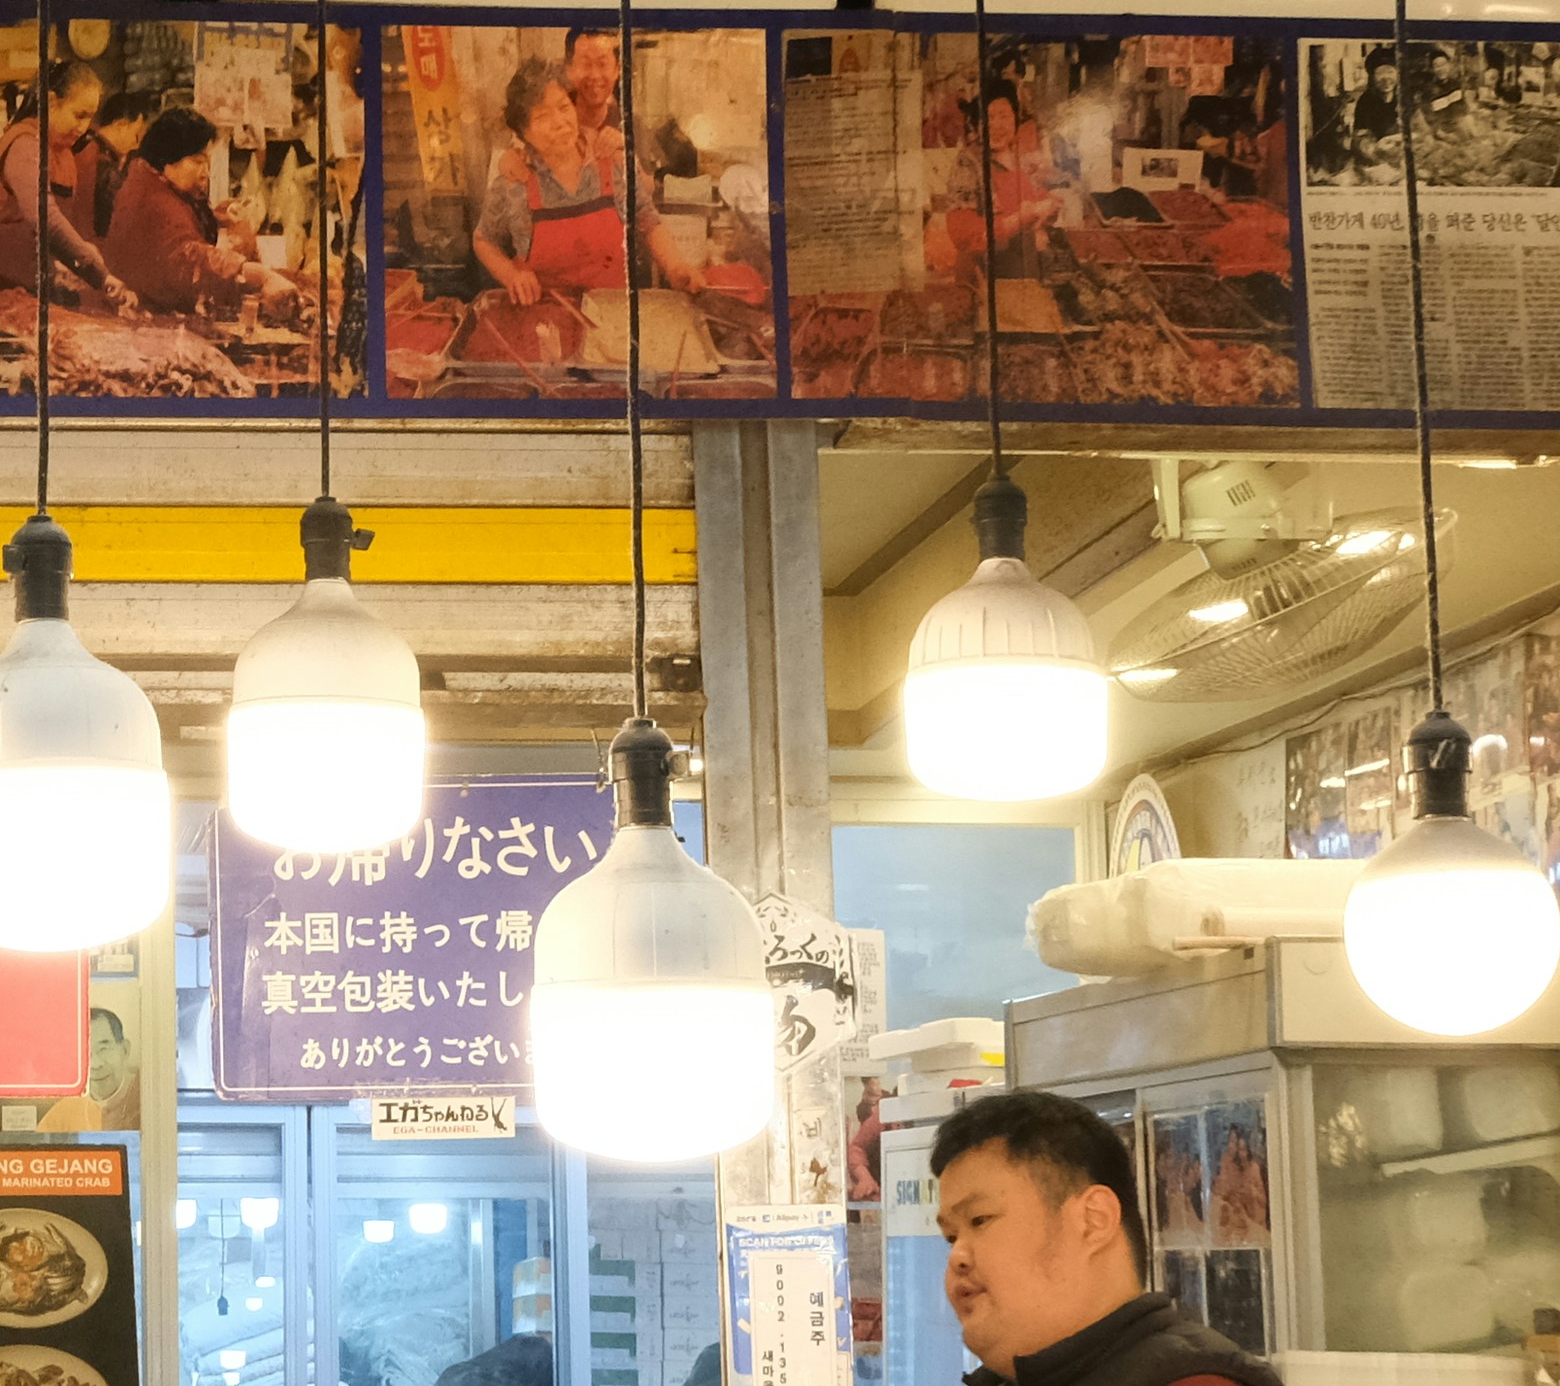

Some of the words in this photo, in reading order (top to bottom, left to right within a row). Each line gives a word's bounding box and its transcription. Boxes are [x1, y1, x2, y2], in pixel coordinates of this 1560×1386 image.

[263, 911, 533, 955] 本国に持って帰
[765, 932, 830, 965] ろっくの
[262, 970, 525, 1015] 真空包装いたし
[300, 1035, 535, 1070] ありがとうござい
[378, 1100, 489, 1124] エガちゃんねる
[1, 1177, 73, 1188] MARINATED
[76, 1177, 110, 1188] CRAB
[29, 1158, 113, 1175] GEJANG
[809, 1291, 826, 1347] 예금주
